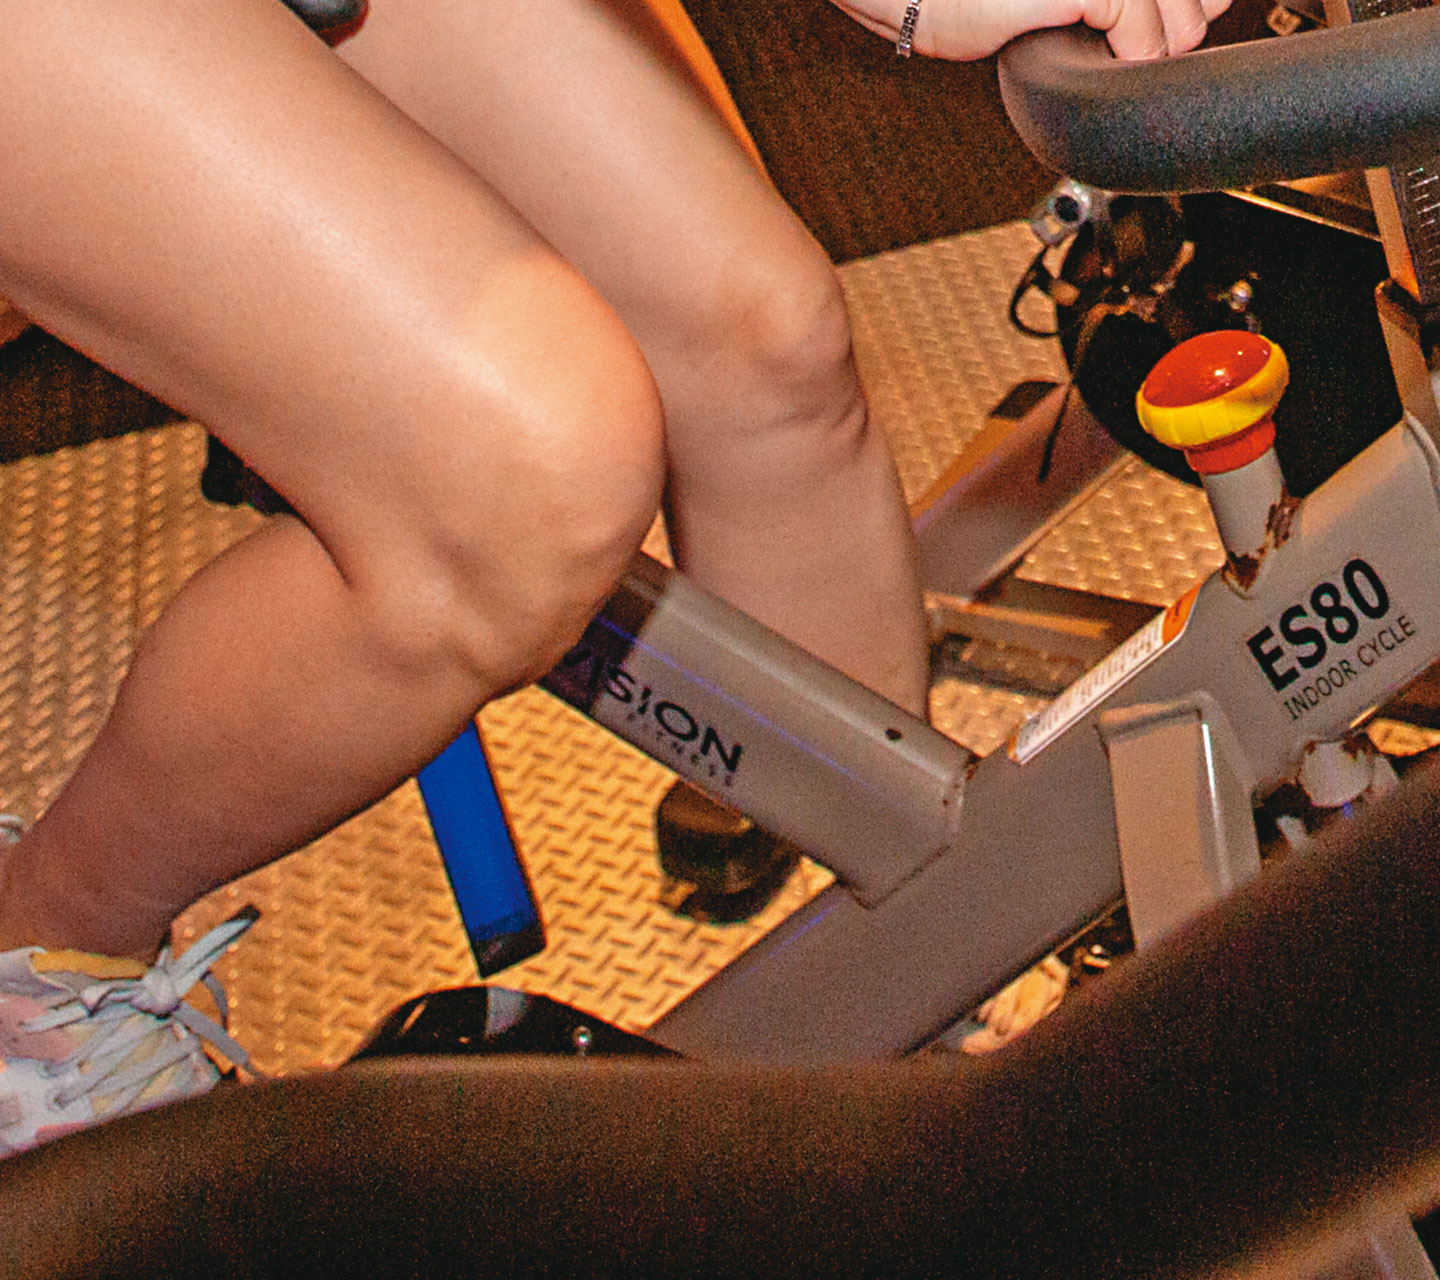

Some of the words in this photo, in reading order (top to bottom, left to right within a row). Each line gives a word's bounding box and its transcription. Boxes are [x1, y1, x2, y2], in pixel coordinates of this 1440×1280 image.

[1247, 558, 1390, 694] ES80
[1283, 658, 1358, 721] INDOOR
[1356, 614, 1416, 668] CYCLE
